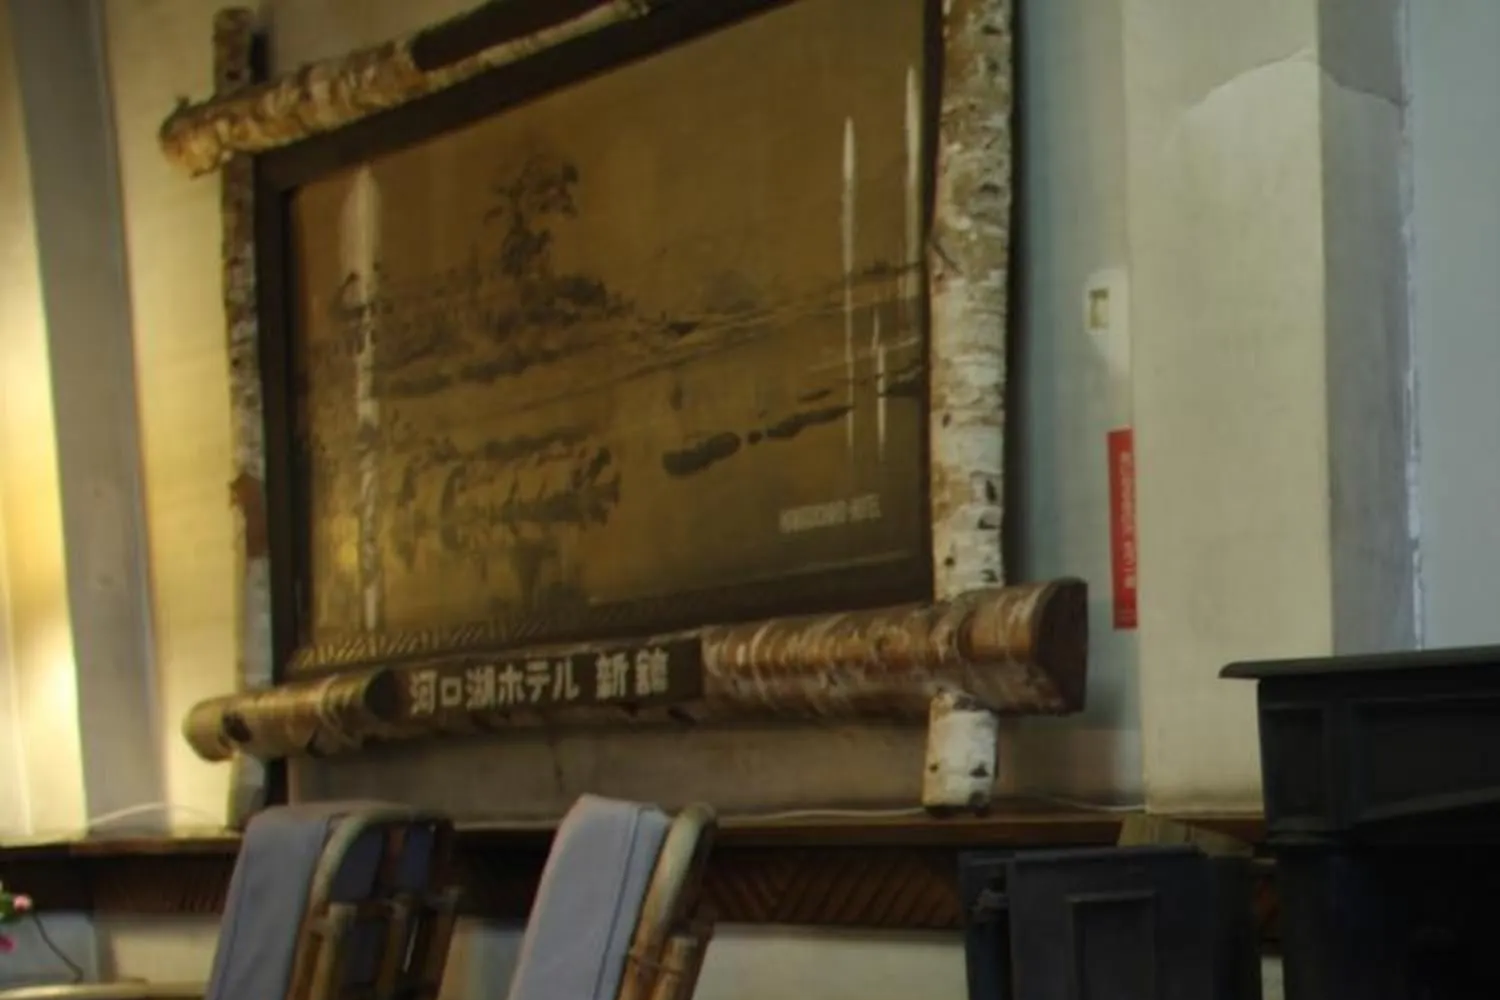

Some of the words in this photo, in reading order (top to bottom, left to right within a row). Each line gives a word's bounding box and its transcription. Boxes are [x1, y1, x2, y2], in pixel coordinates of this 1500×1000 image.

[410, 656, 579, 716] 河口湖ホテル
